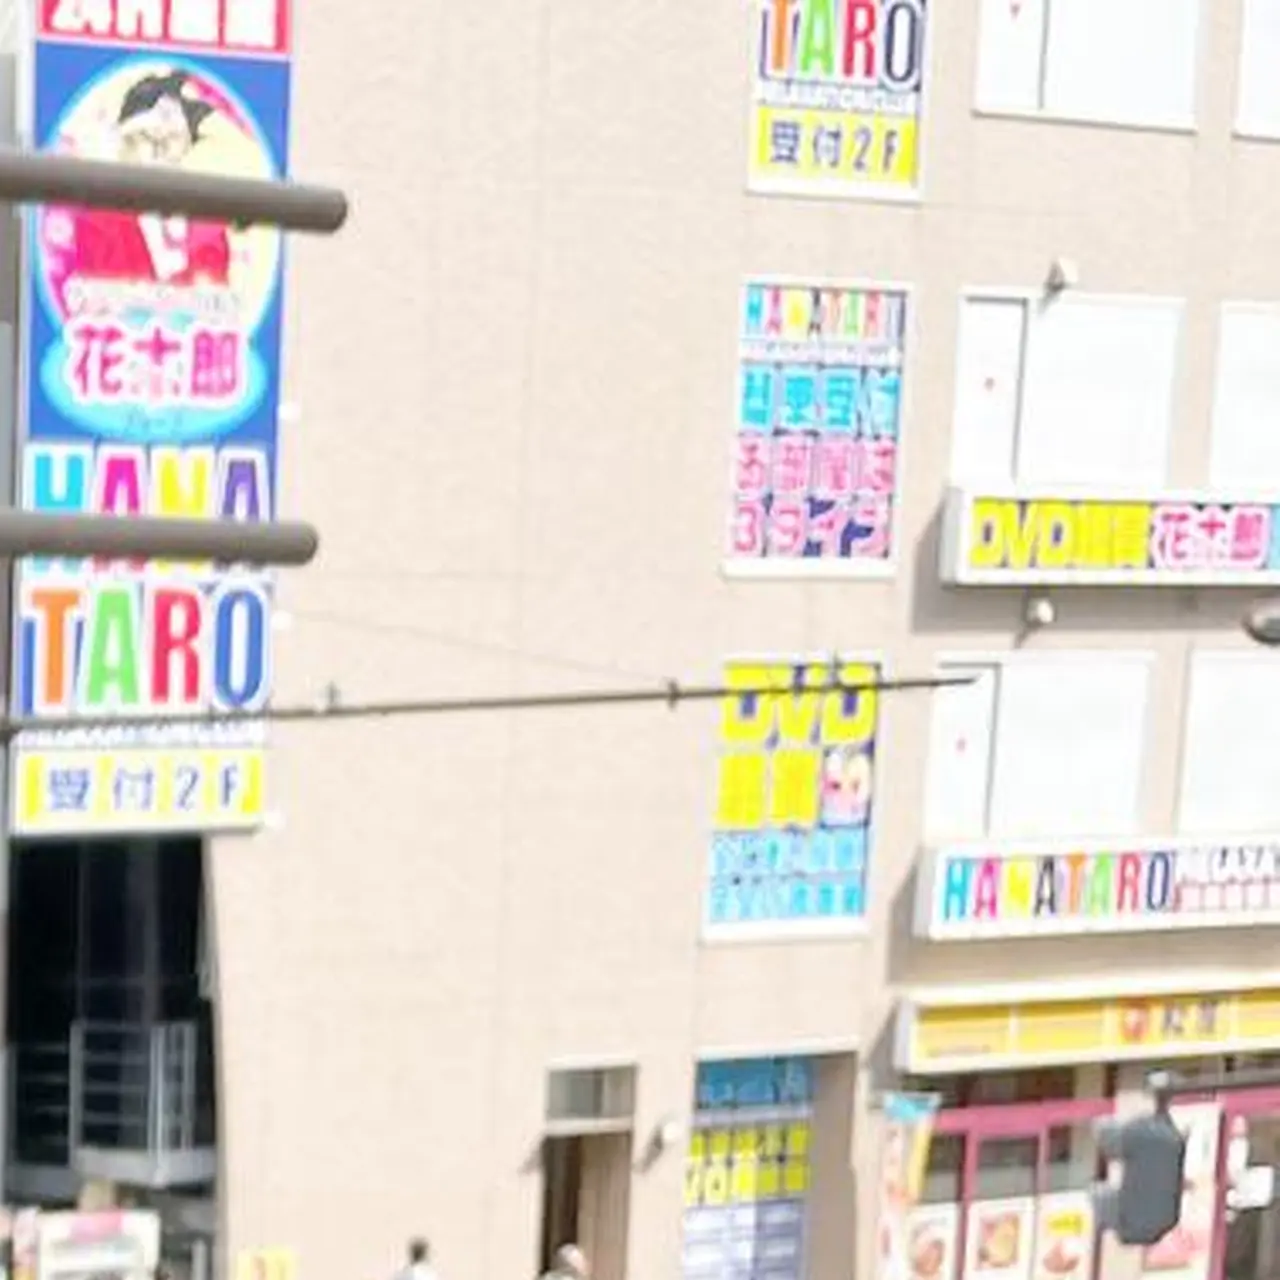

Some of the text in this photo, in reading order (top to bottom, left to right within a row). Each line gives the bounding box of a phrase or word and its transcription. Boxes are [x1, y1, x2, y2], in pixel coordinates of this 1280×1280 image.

[767, 0, 917, 82] TARO
[30, 452, 266, 574] HANA
[31, 586, 266, 708] TARO
[721, 663, 878, 743] DVD
[943, 850, 1174, 921] HANATARO
